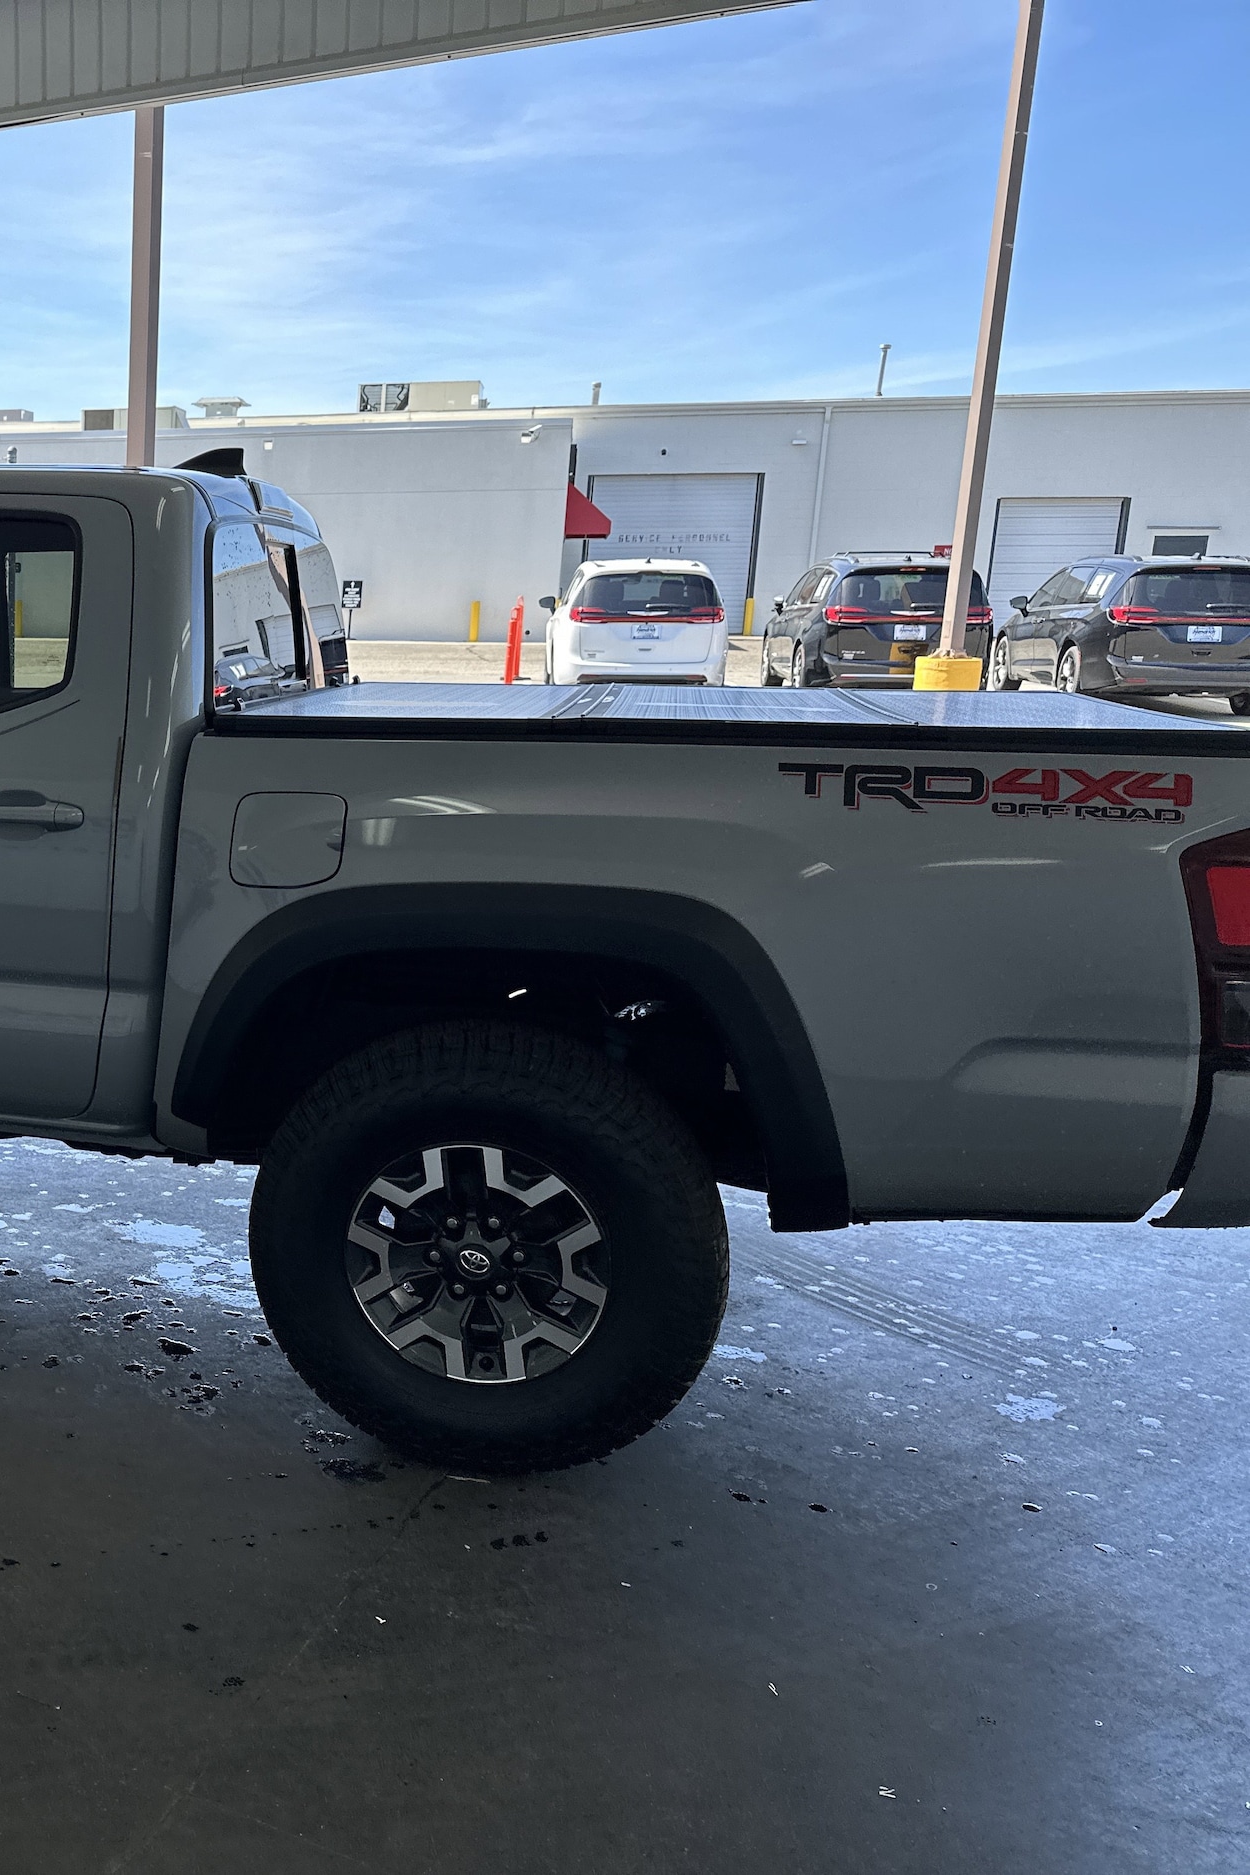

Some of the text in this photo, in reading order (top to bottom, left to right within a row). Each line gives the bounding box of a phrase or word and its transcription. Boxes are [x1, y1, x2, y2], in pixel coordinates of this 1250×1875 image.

[618, 534, 661, 543] SERVCE
[654, 545, 683, 554] LY
[778, 762, 989, 813] TRD
[991, 802, 1186, 824] OFF ROAD
